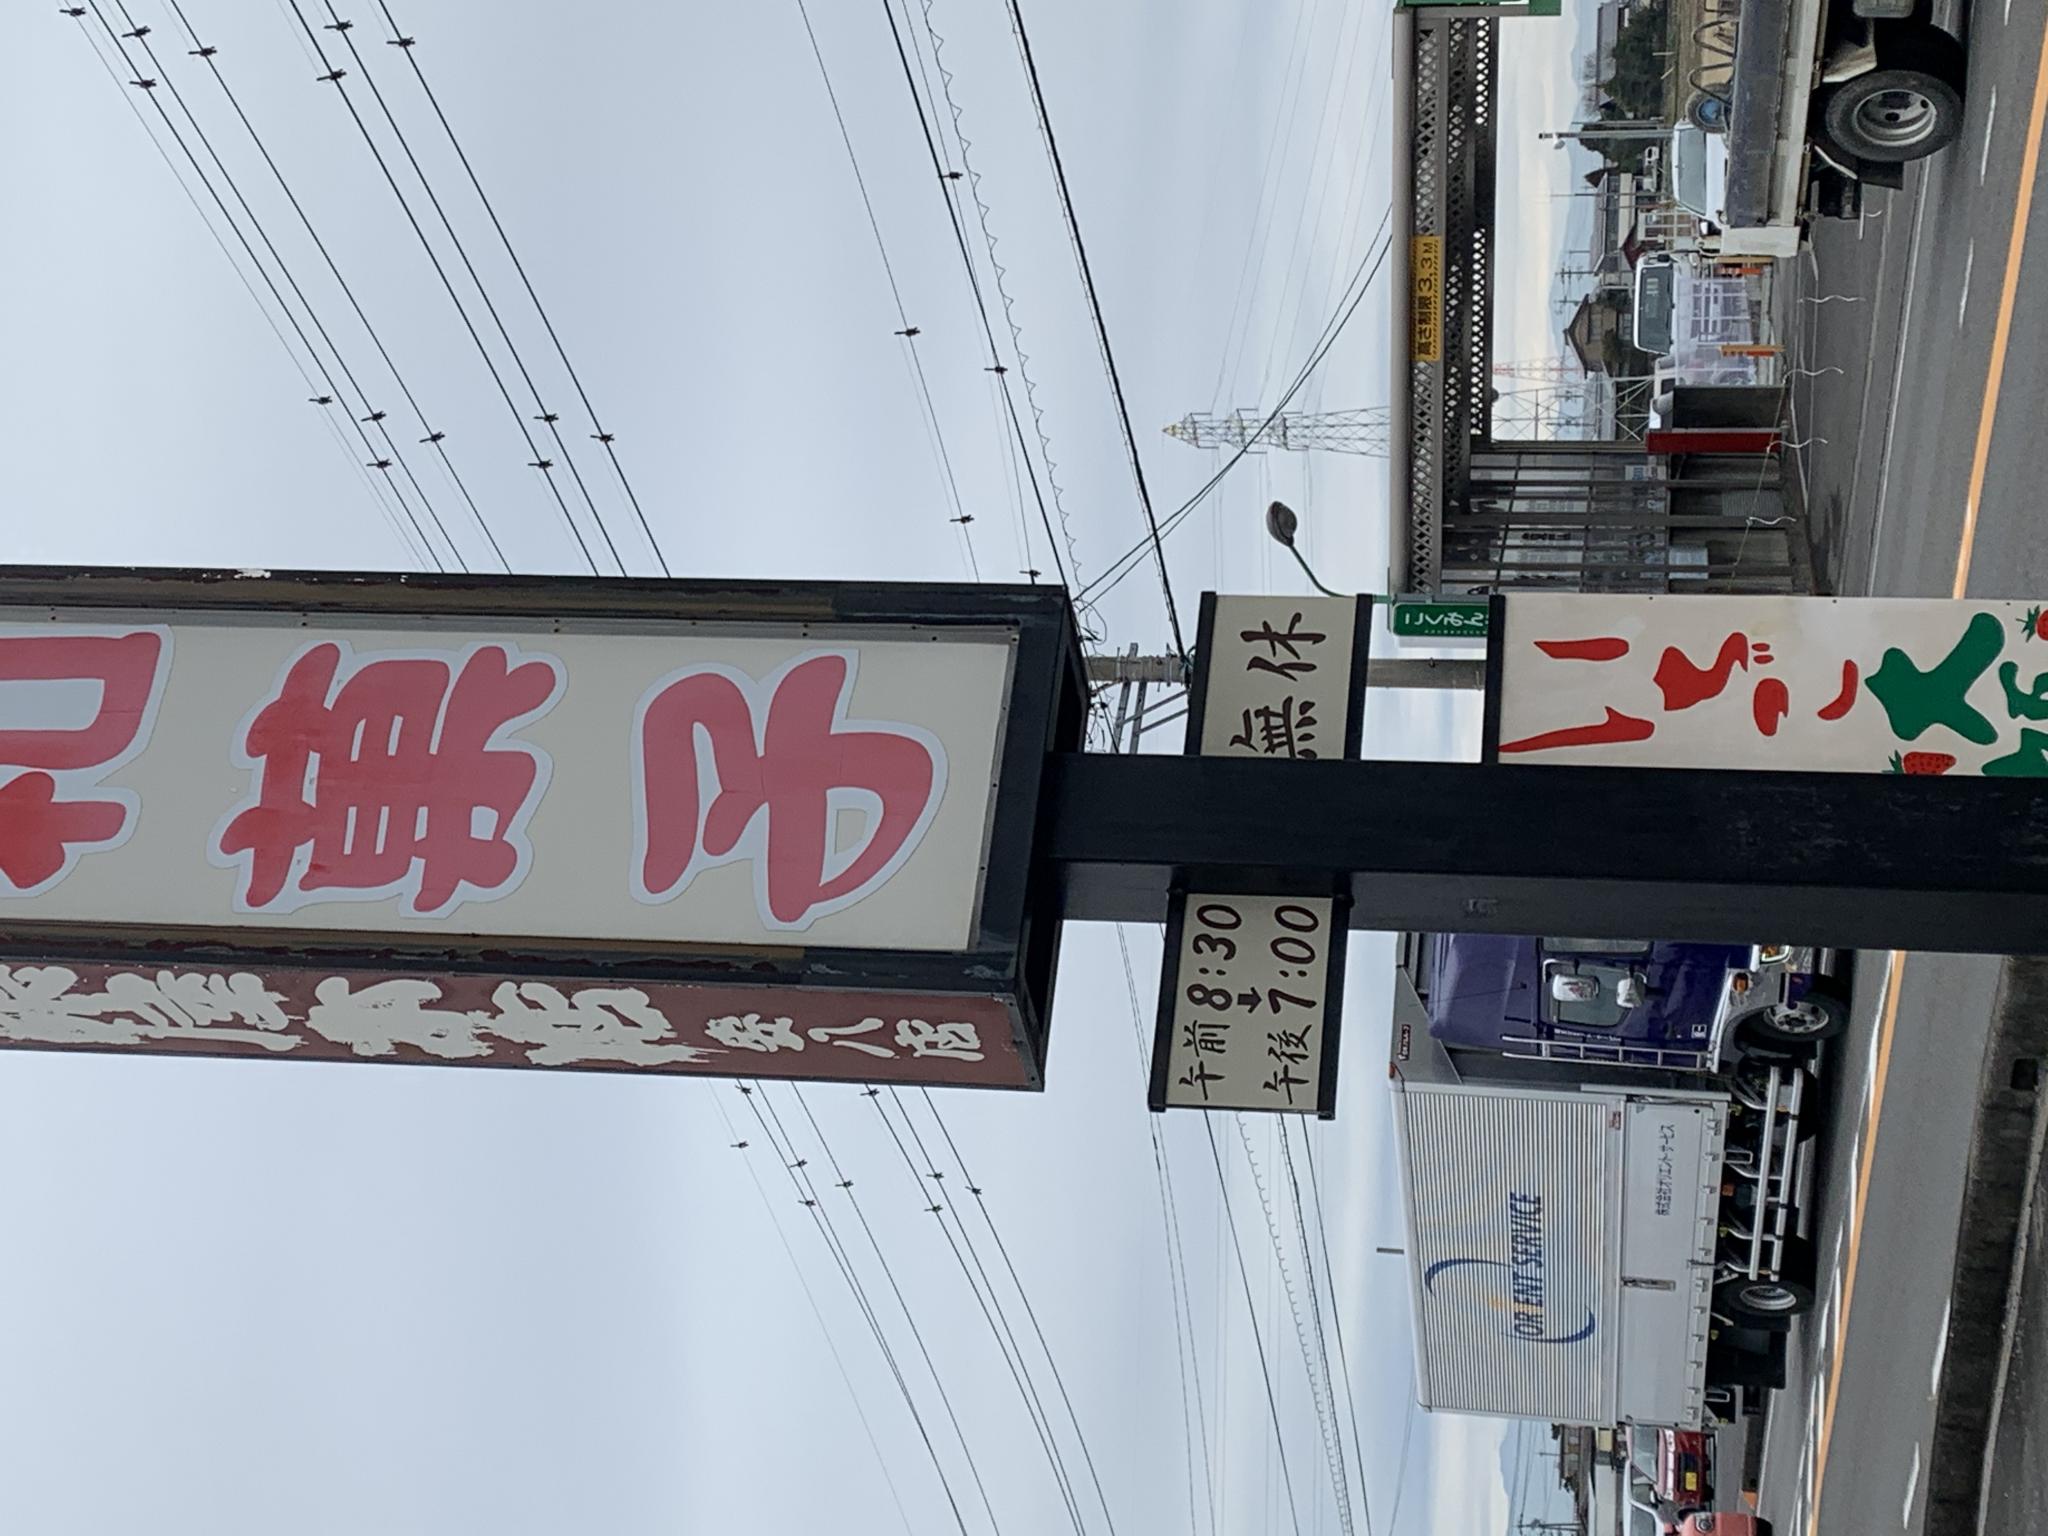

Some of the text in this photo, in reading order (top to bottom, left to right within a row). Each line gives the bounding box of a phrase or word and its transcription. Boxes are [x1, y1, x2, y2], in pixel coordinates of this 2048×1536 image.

[1404, 611, 1488, 628] こくみん
[1227, 611, 1327, 761] 無休
[704, 1013, 986, 1062] 安八店
[1509, 1191, 1543, 1268] SERVICE
